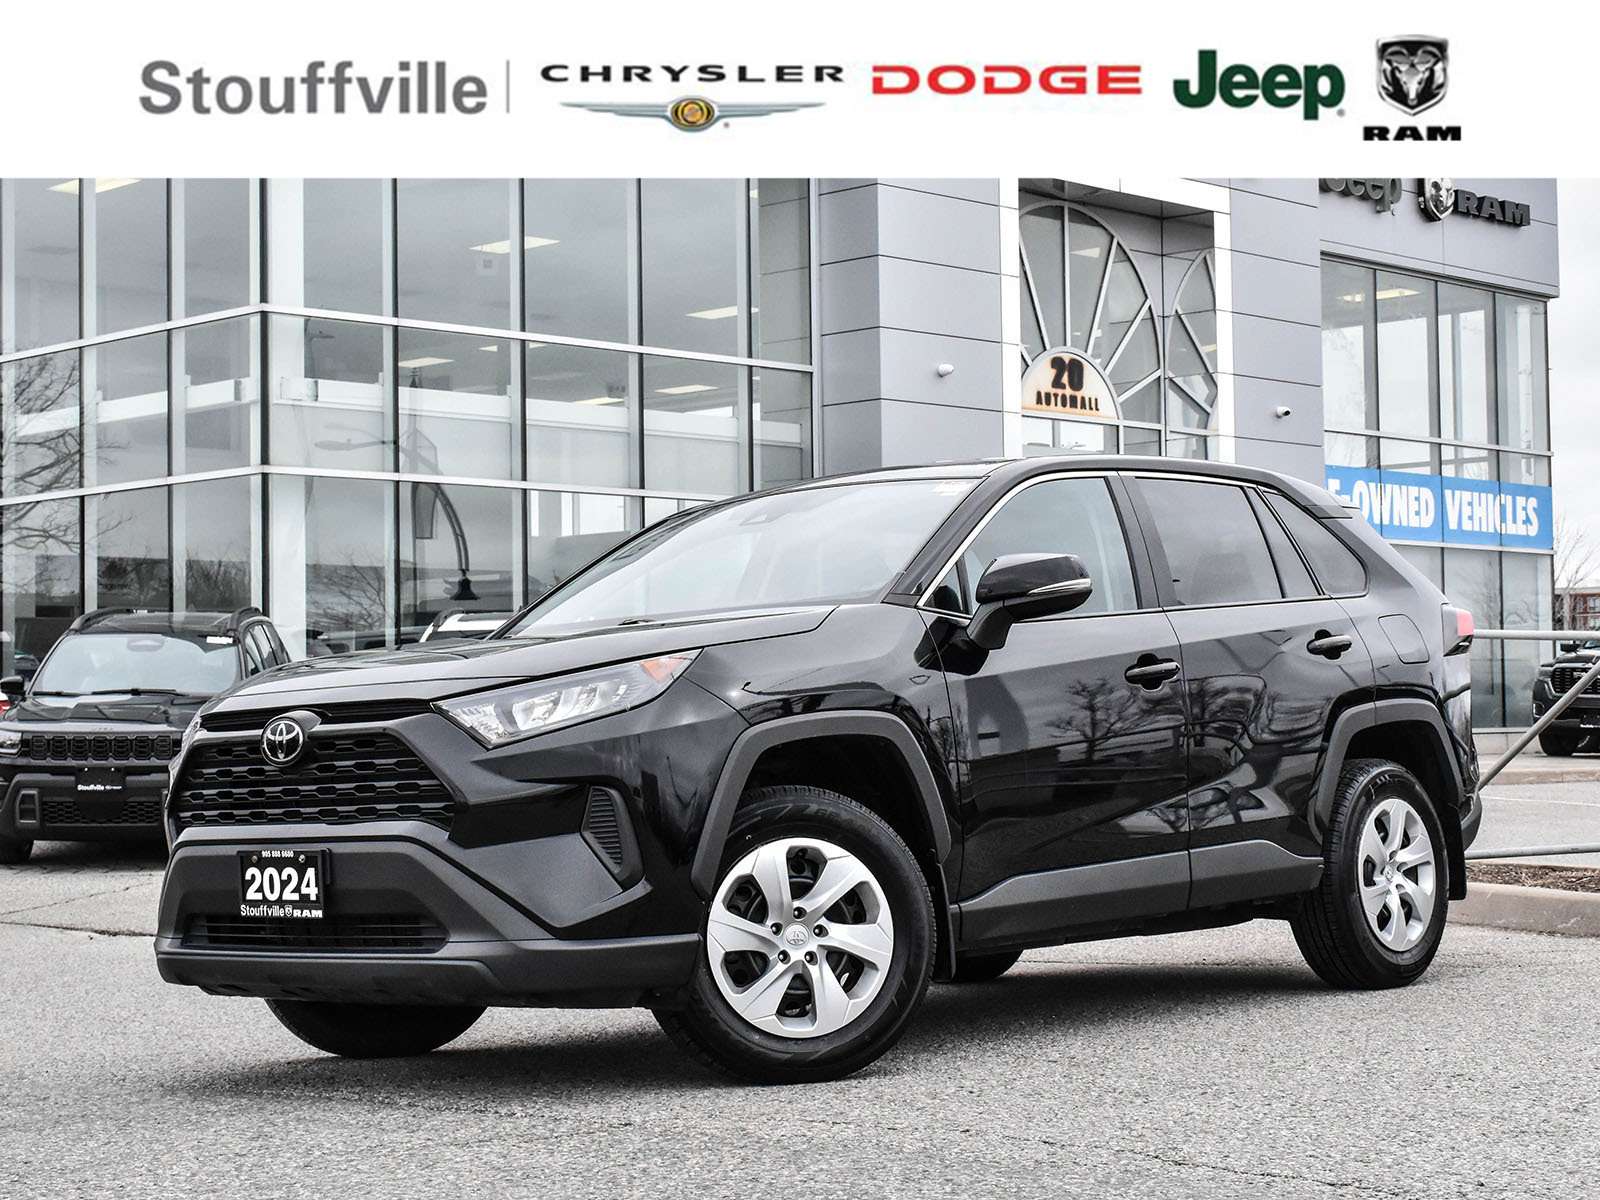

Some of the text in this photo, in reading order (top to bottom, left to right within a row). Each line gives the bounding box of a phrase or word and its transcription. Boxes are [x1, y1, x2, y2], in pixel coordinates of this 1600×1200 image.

[1454, 189, 1530, 226] RAM
[1051, 356, 1084, 391] 20
[1036, 391, 1099, 411] AUTOMALL
[1444, 489, 1539, 537] VEHICLES
[245, 867, 318, 901] 2024
[240, 904, 322, 918] Stouffville RAM
